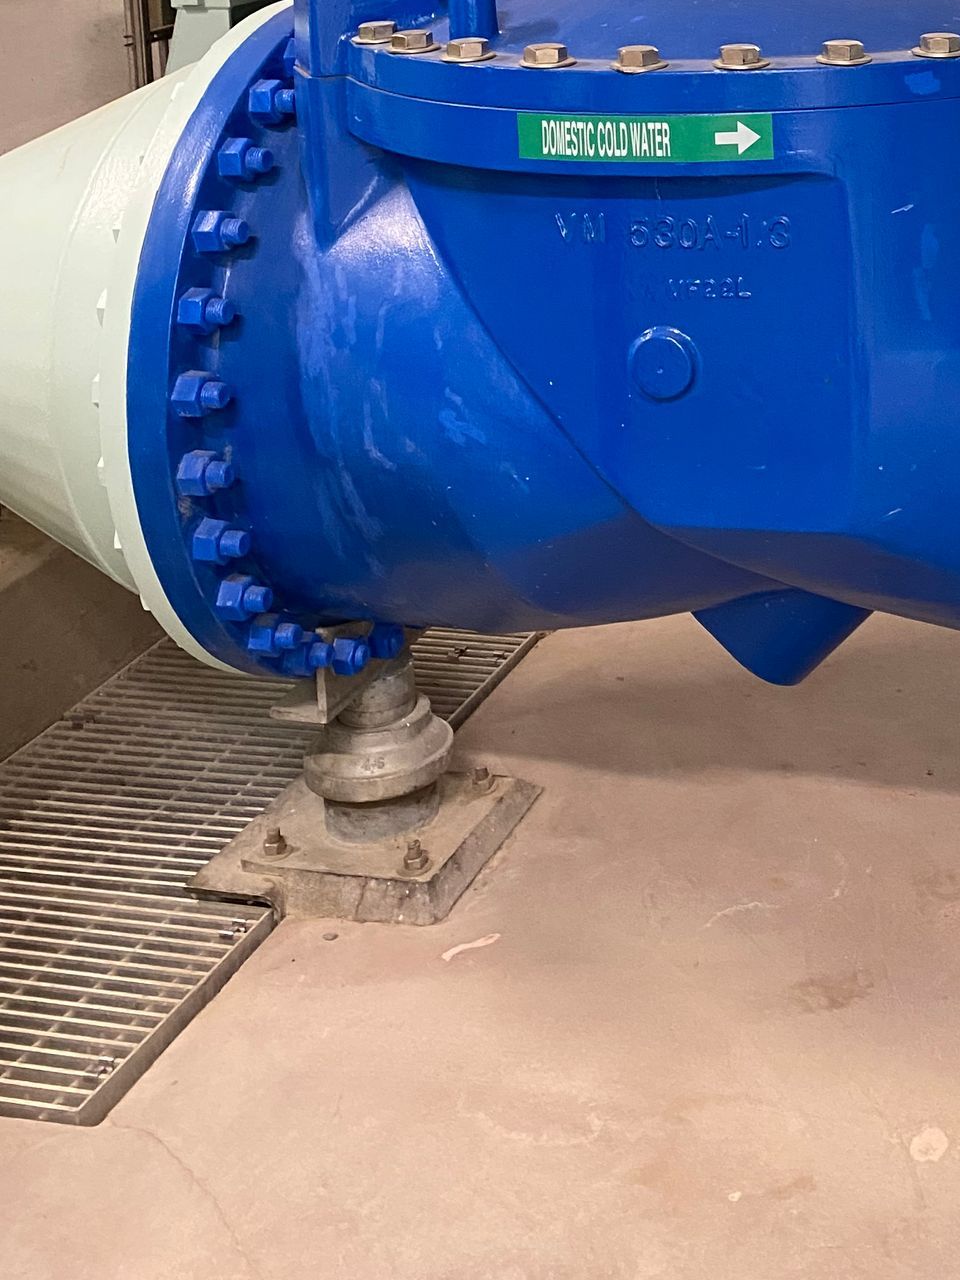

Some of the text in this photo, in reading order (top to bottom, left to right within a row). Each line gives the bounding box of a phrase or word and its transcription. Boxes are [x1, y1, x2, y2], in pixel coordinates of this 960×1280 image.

[541, 119, 671, 157] DOMESTIC COLD WATER
